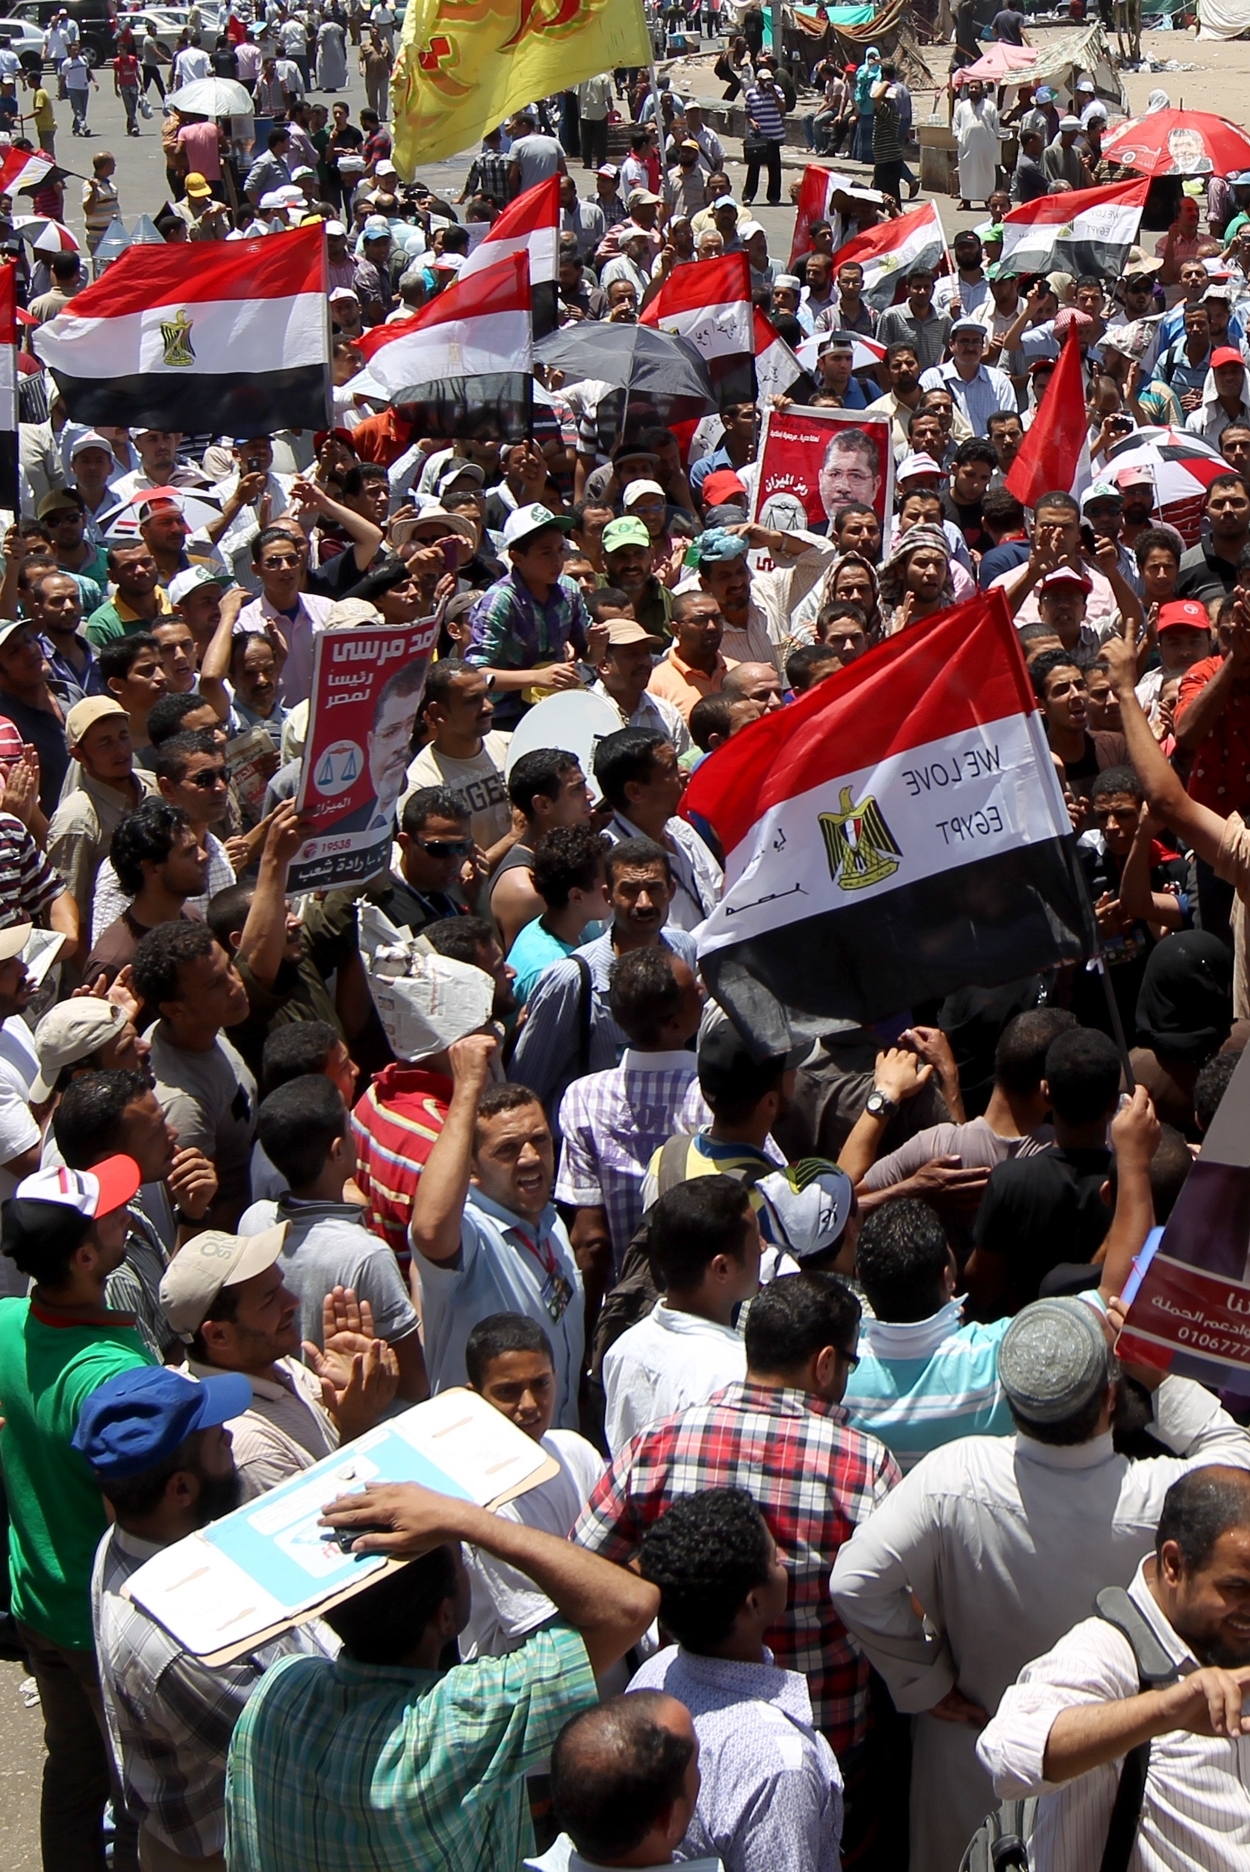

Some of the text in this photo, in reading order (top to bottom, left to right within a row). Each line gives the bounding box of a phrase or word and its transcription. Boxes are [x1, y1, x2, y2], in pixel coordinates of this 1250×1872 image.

[765, 471, 810, 498] رمز الميزان
[332, 628, 436, 666] مد مرسى
[325, 688, 371, 710] لمصر
[321, 838, 352, 853] 19538
[298, 858, 334, 883] شعب
[1152, 1294, 1204, 1325] الحملة
